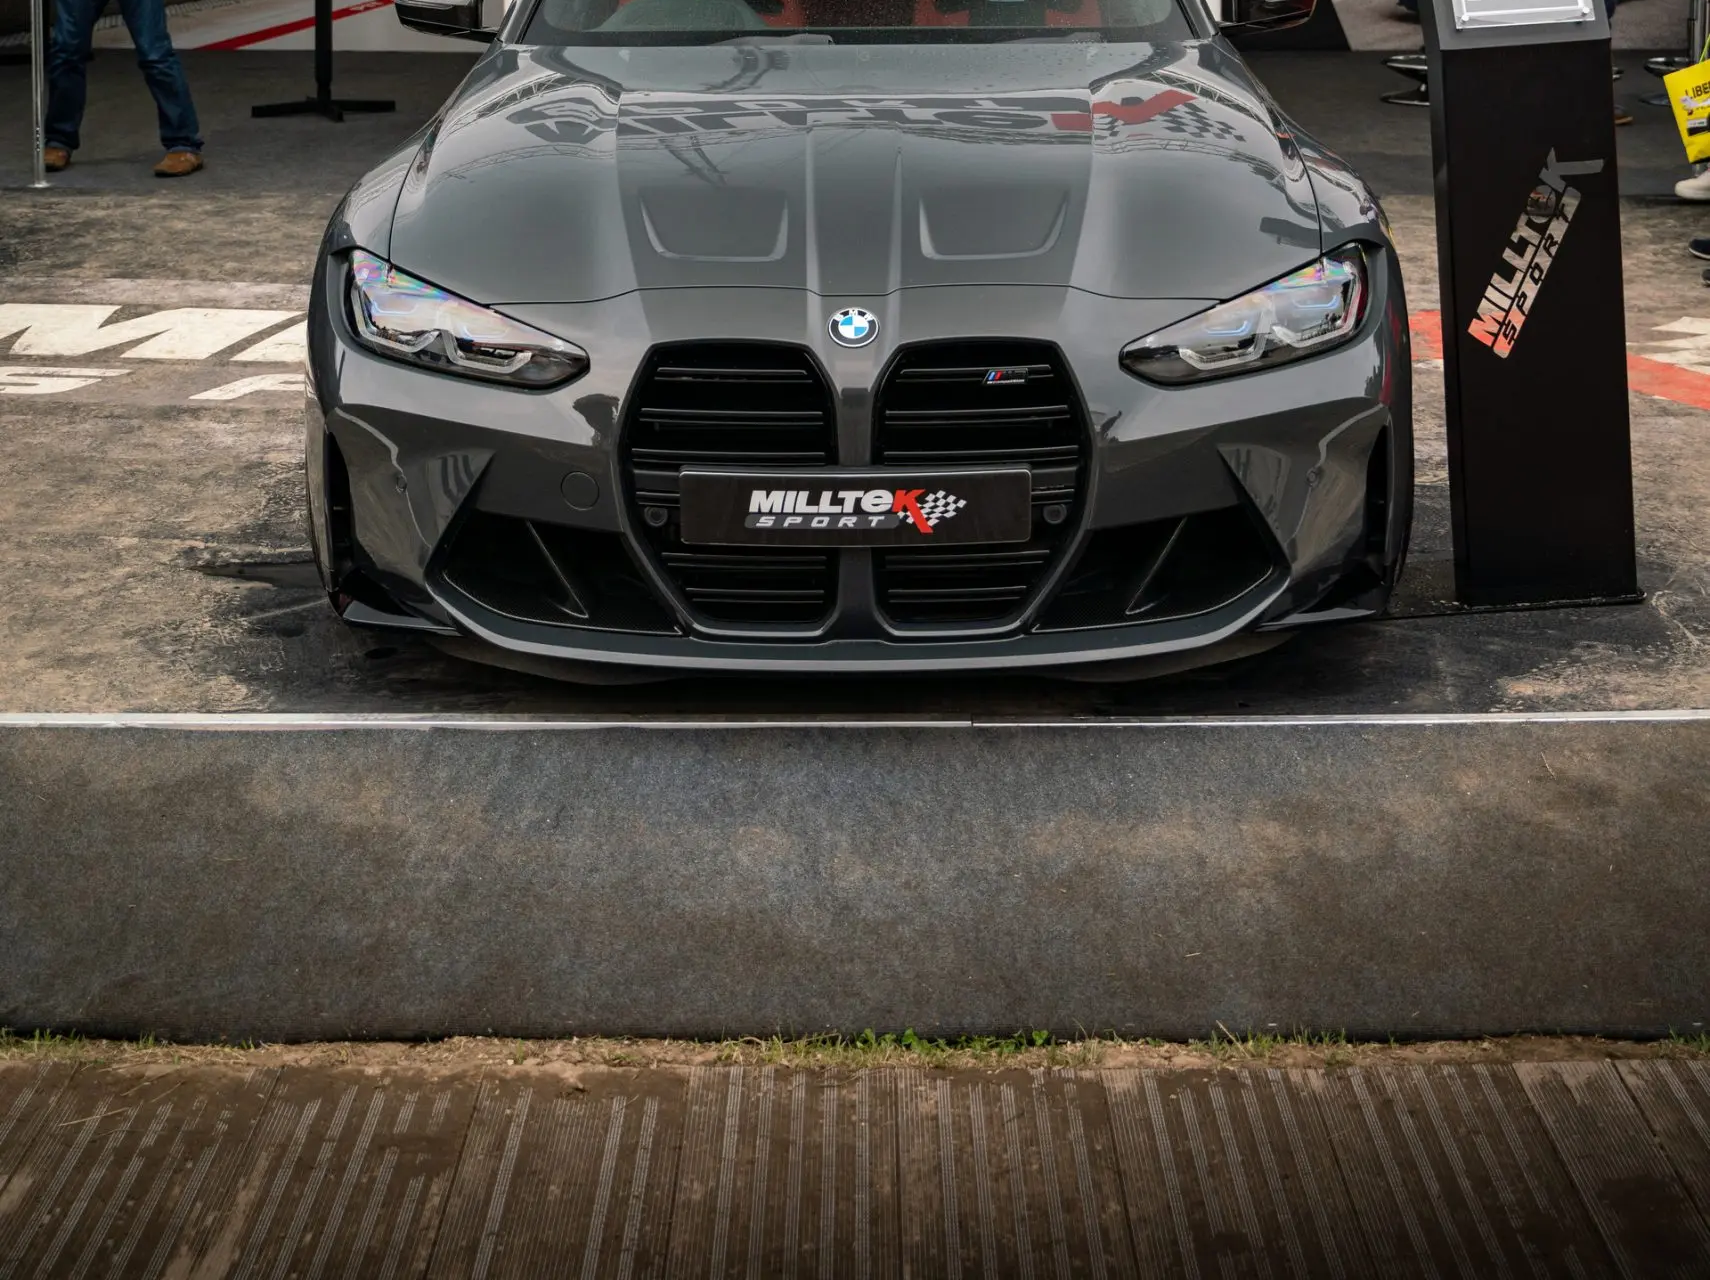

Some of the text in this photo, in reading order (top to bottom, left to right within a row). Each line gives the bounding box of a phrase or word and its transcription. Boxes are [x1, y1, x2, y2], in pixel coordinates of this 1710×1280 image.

[1502, 202, 1571, 346] SPORT
[832, 308, 875, 322] BMW
[755, 515, 885, 528] SPORT
